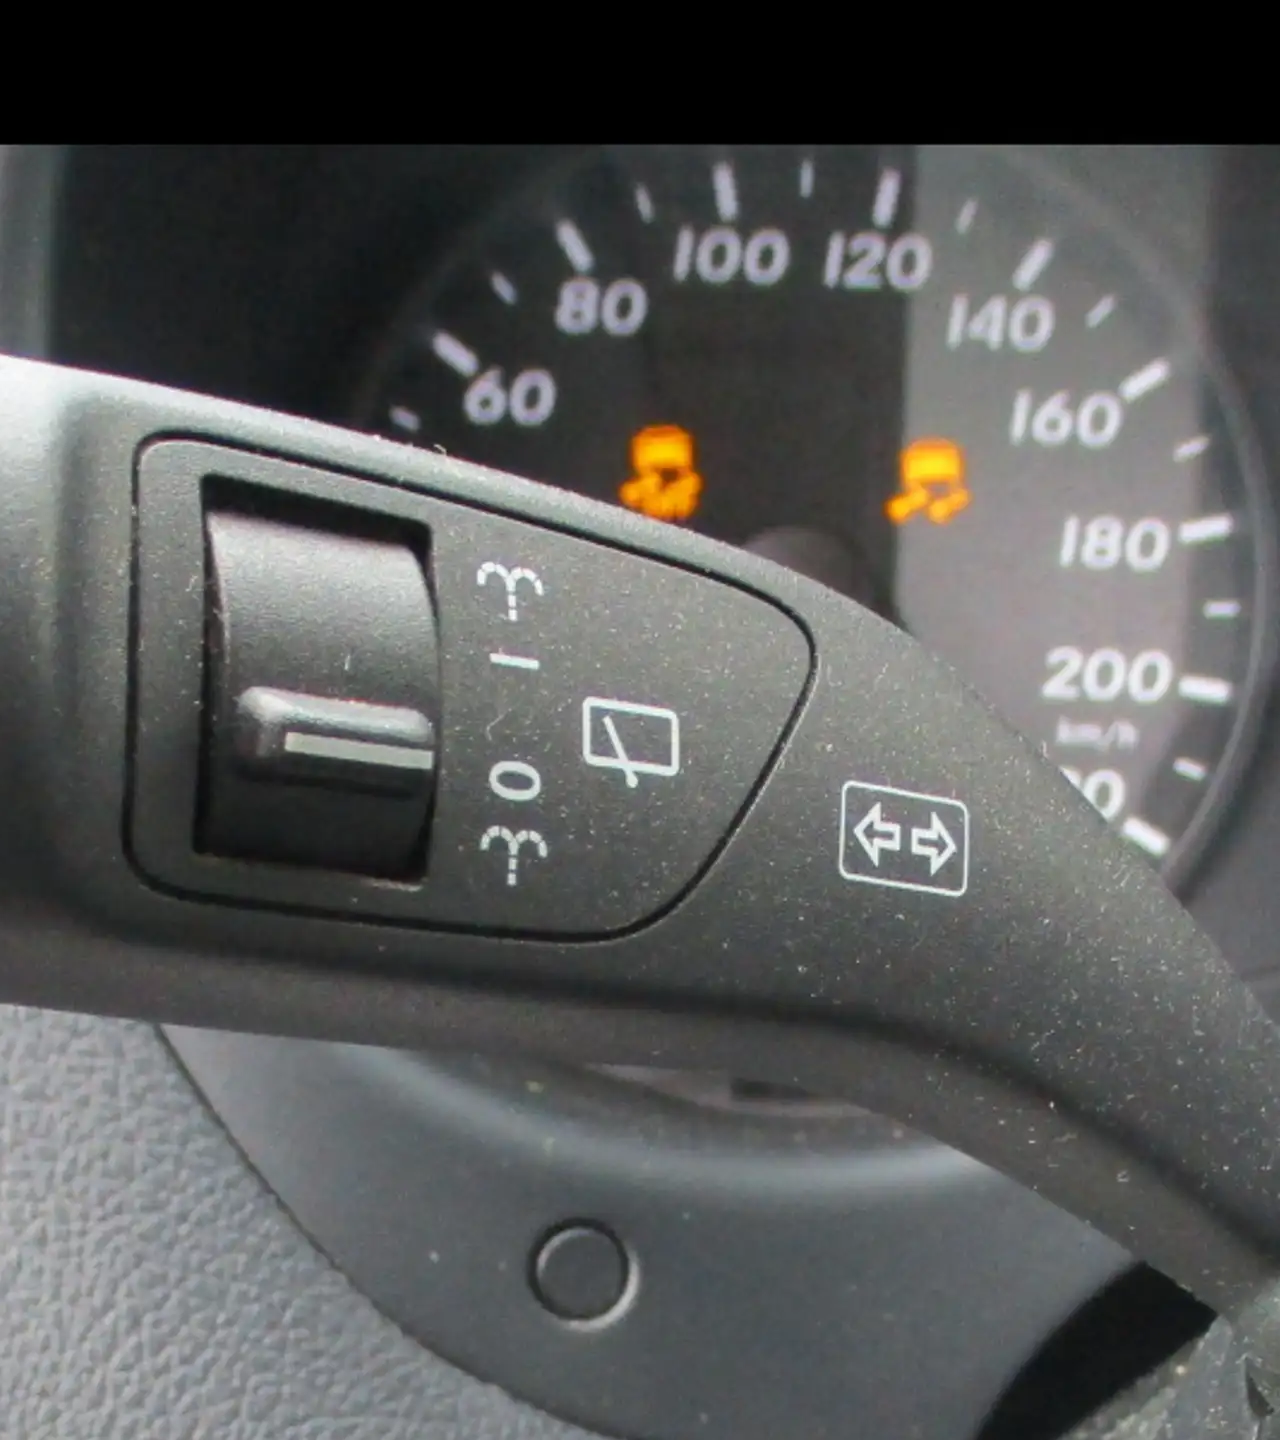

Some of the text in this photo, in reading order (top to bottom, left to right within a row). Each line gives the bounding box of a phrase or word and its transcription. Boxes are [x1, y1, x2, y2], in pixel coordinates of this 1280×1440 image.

[674, 225, 790, 285] 100
[824, 230, 933, 292] 120
[555, 277, 649, 337] 80
[946, 295, 1055, 352] 140
[464, 366, 557, 426] 60
[1010, 390, 1122, 450] 160
[1058, 514, 1170, 572] 180
[1040, 645, 1173, 703] 200
